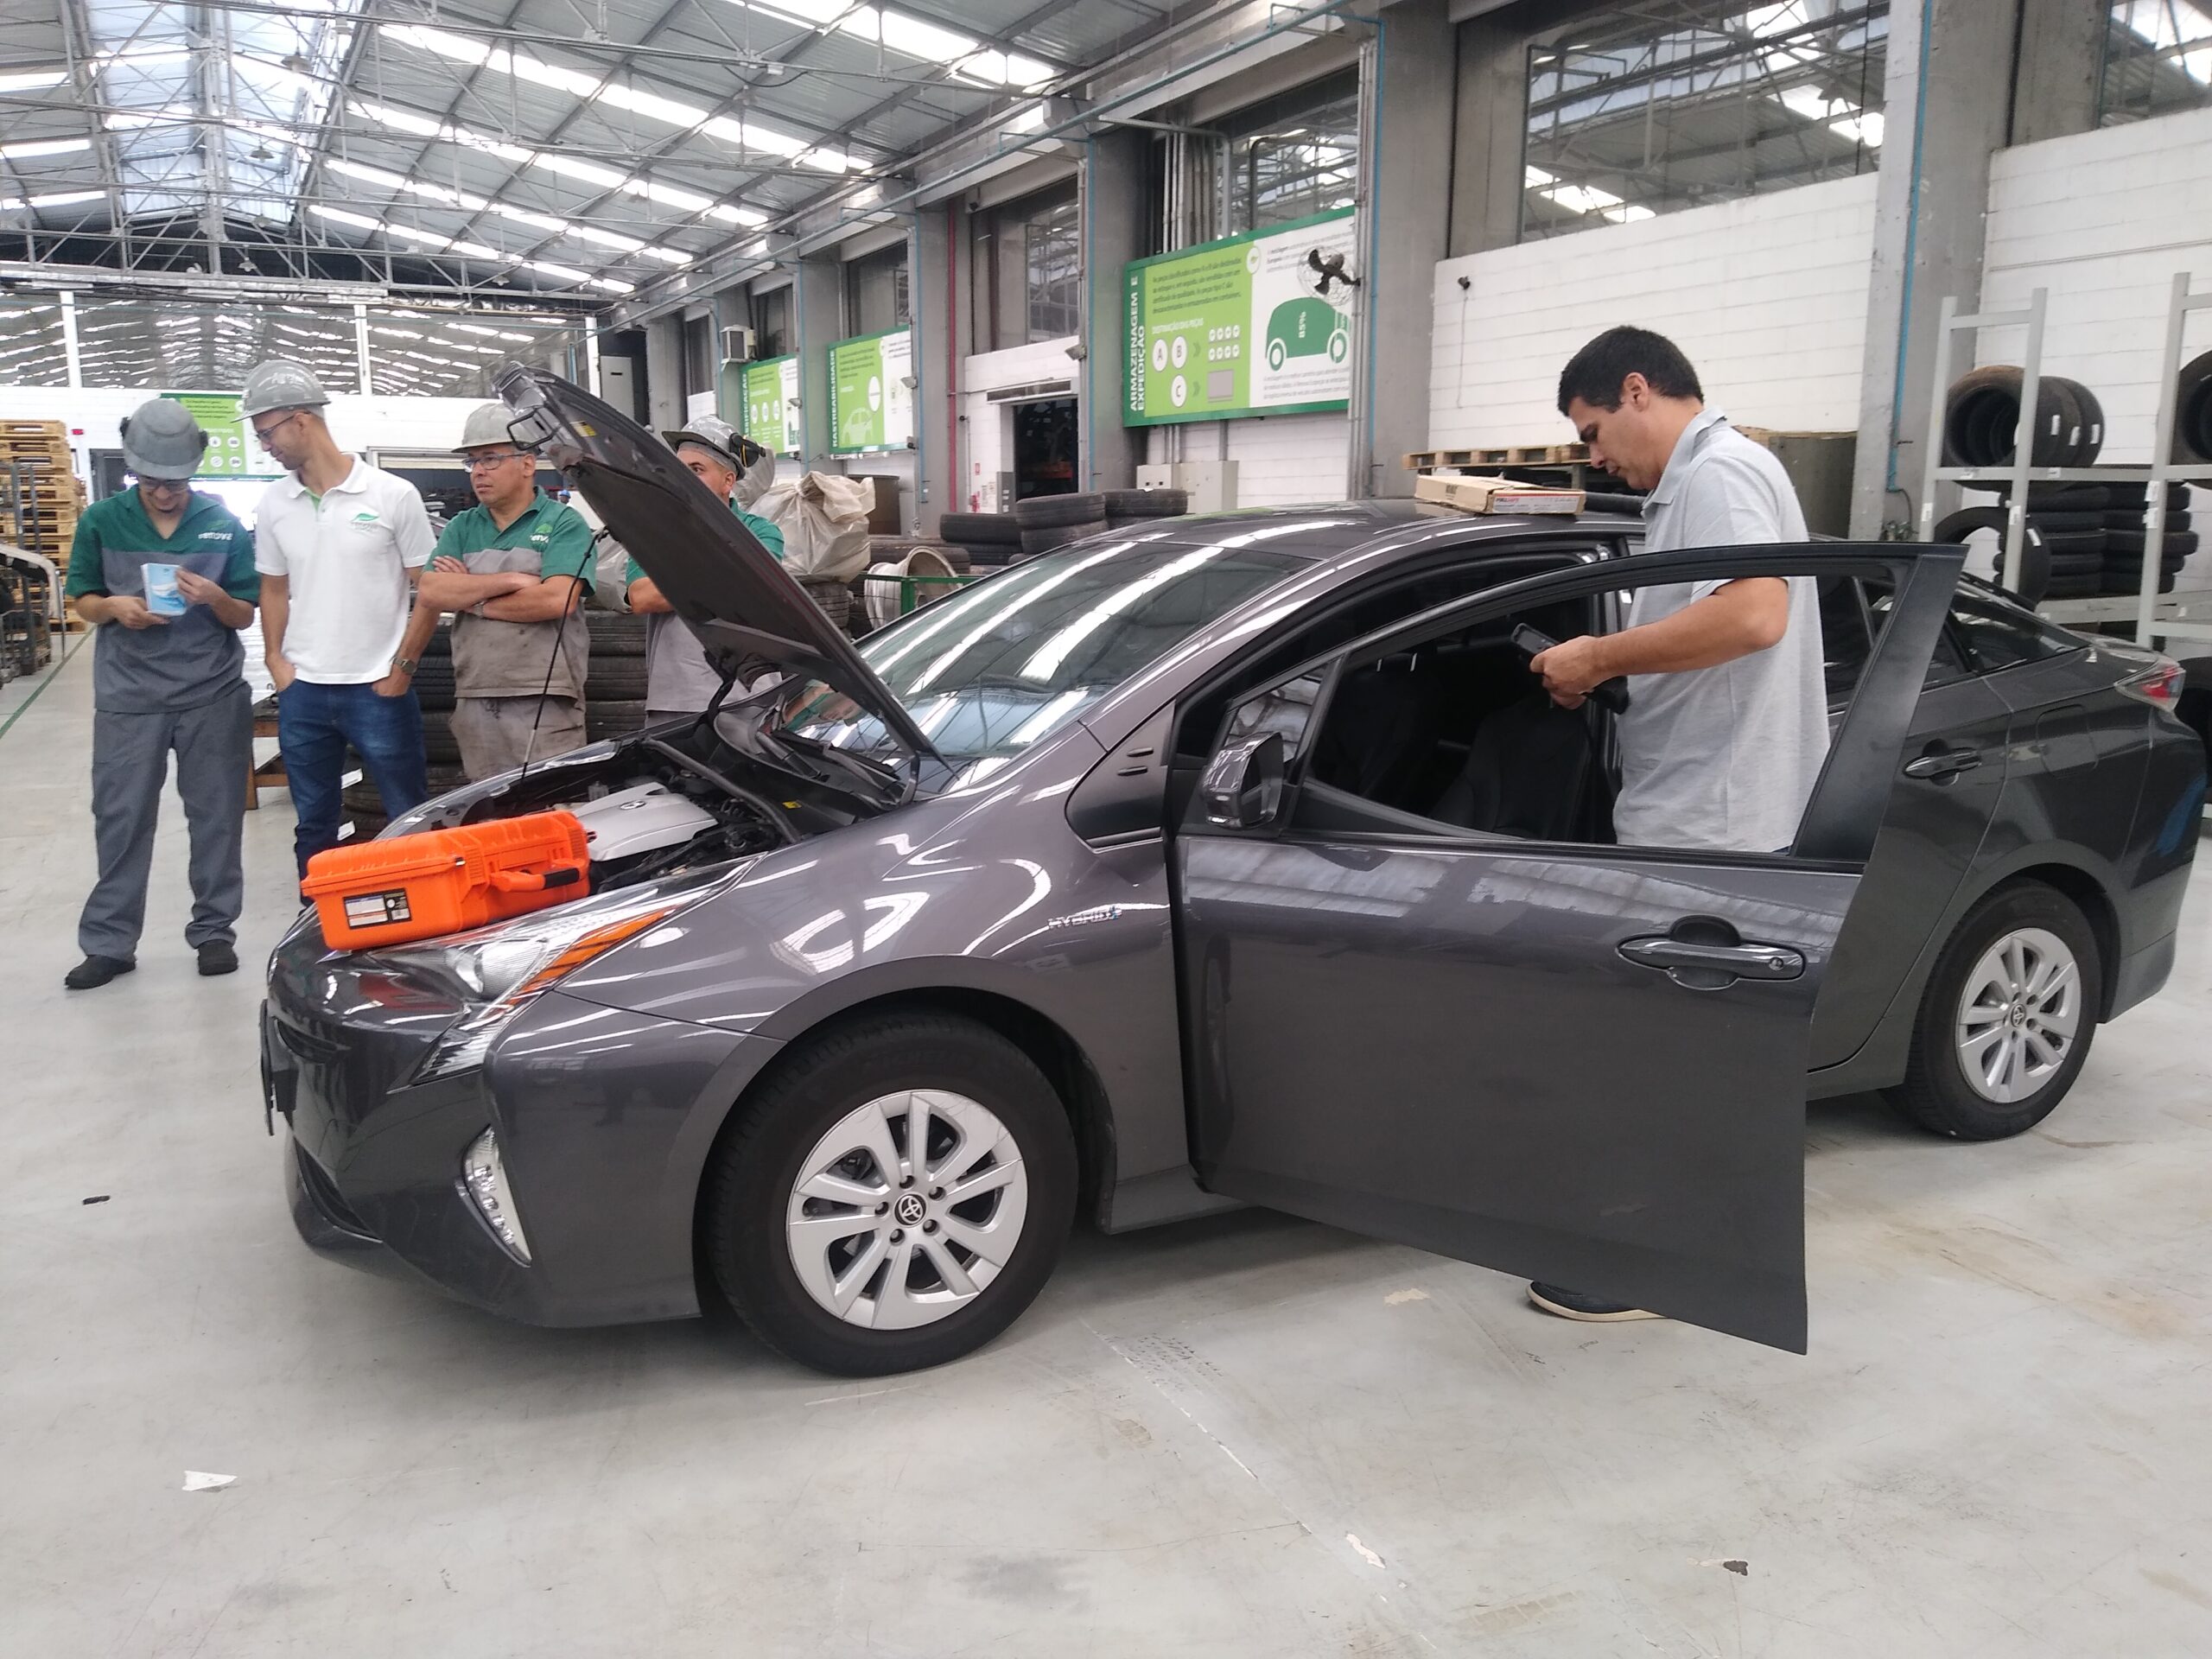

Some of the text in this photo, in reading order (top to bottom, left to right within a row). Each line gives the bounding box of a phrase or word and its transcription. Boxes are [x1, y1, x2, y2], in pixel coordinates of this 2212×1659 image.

[1298, 311, 1306, 338] 85%
[1130, 276, 1139, 410] ARMAZENAGEM E
[1156, 345, 1183, 361] A B
[1174, 381, 1182, 398] C
